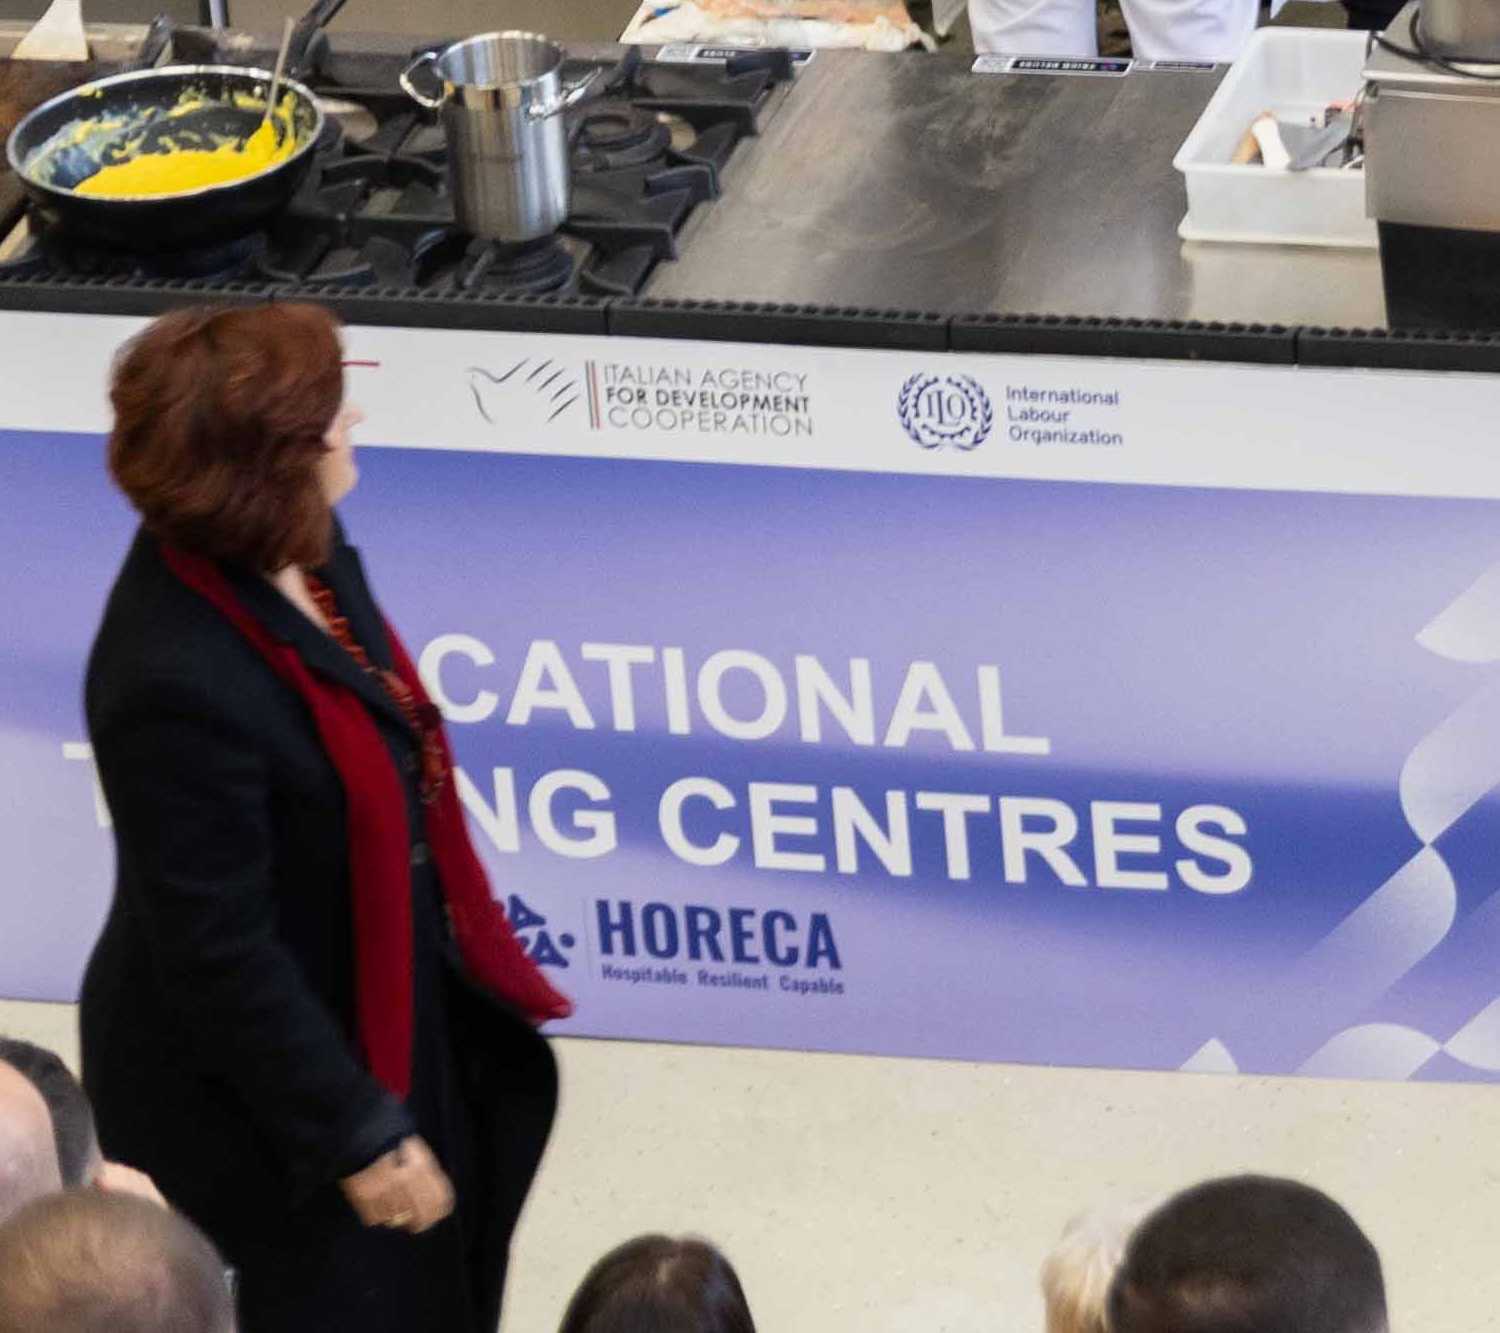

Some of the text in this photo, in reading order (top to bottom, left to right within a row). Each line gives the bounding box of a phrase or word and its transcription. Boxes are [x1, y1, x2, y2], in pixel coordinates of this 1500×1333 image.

[603, 364, 808, 393] ITALIAN AGENCY
[605, 386, 810, 414] FOR DEVELOPMENT
[1006, 385, 1119, 406] International
[607, 406, 813, 437] COOPERATION
[1007, 406, 1071, 423] Labour
[1009, 425, 1123, 446] Organization
[418, 633, 1050, 756] CATIONAL
[658, 777, 1254, 895] CENTRES
[596, 899, 842, 970] HORECA
[601, 964, 844, 996] Hospitable Resilient Capable
